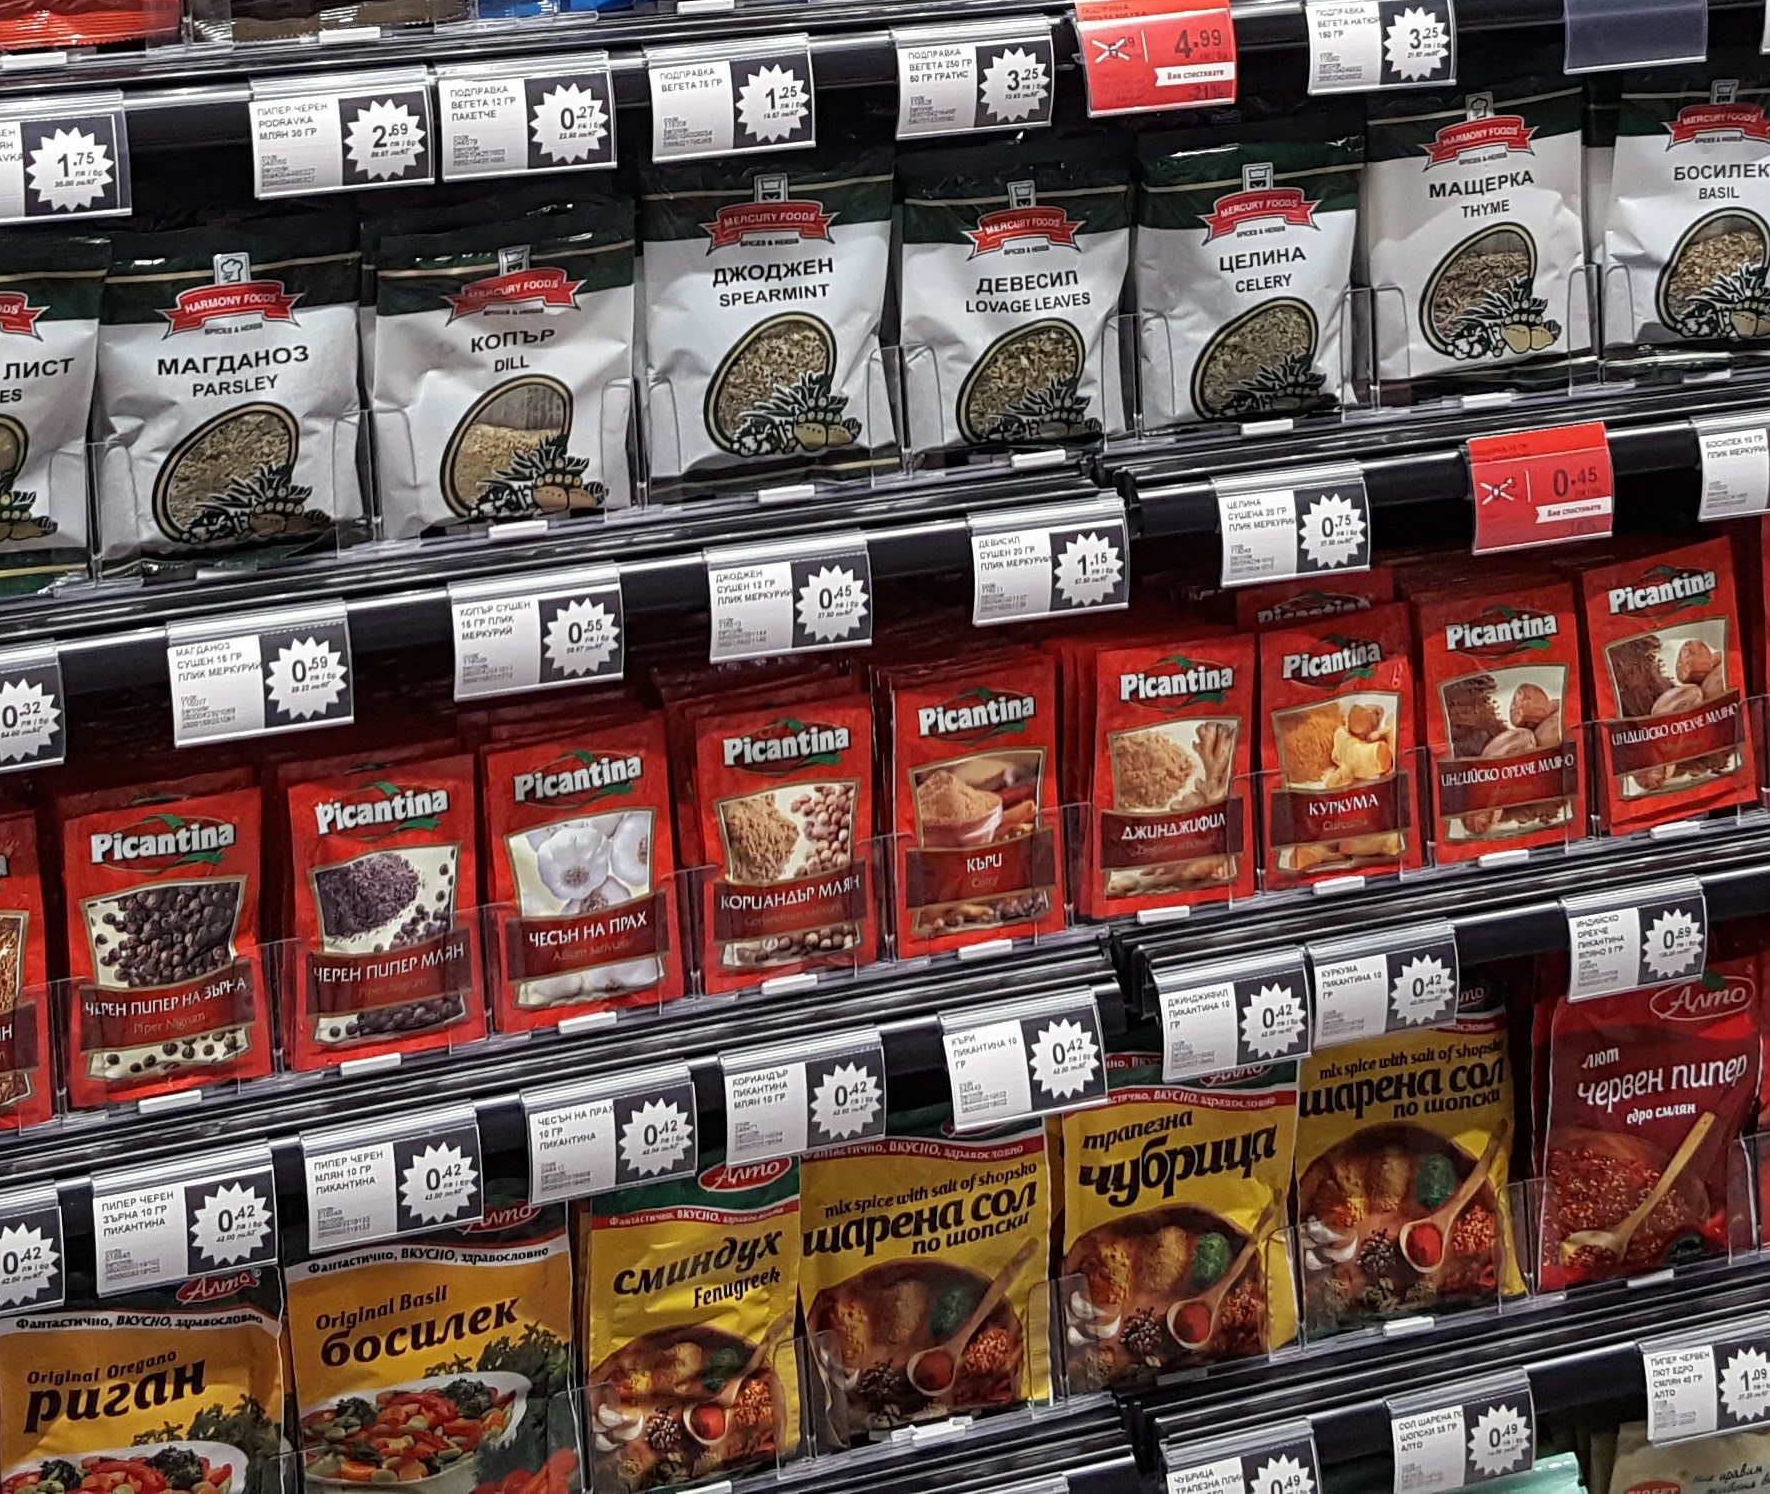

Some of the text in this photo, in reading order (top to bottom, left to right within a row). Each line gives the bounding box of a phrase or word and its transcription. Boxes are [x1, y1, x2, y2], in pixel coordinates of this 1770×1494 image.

[1429, 170, 1534, 199] МАЩЕРКА
[1673, 162, 1770, 181] БОСИЛЕК
[1698, 185, 1740, 200] BASIL
[1461, 198, 1510, 218] THYME
[1218, 245, 1307, 274] ЦЕЛИНА
[719, 284, 830, 307] SPEARMINT
[976, 270, 1079, 297] ДЕВЕСИЛ
[1235, 273, 1291, 294] CELERY
[965, 292, 1090, 314] LOVAGE LEAVES
[2, 357, 74, 379] ЛИСТ
[157, 345, 309, 377] МАГДАНОЗ
[494, 356, 529, 373] DILL
[192, 375, 278, 397] PARSLEY
[1552, 467, 1598, 497] 0.45
[1077, 552, 1108, 576] 1.15
[1445, 614, 1557, 651] Picantina
[723, 725, 850, 765] Picantina
[315, 787, 448, 834] Picantina
[1308, 794, 1378, 817] КУРКУМА
[967, 852, 1003, 873] КЪРИ
[529, 912, 647, 948] ЧЕСЪН НА ПРАХ
[1582, 1047, 1620, 1067] лют
[1577, 1052, 1748, 1106] червен пипер
[1080, 1124, 1278, 1206] чубрица
[801, 1182, 1037, 1259] шарена сол
[613, 1233, 782, 1297] сминдух
[694, 1267, 780, 1309] Fenugreek
[315, 1285, 448, 1331] Original Basil
[321, 1297, 520, 1368] босилек
[25, 1361, 206, 1433] риган
